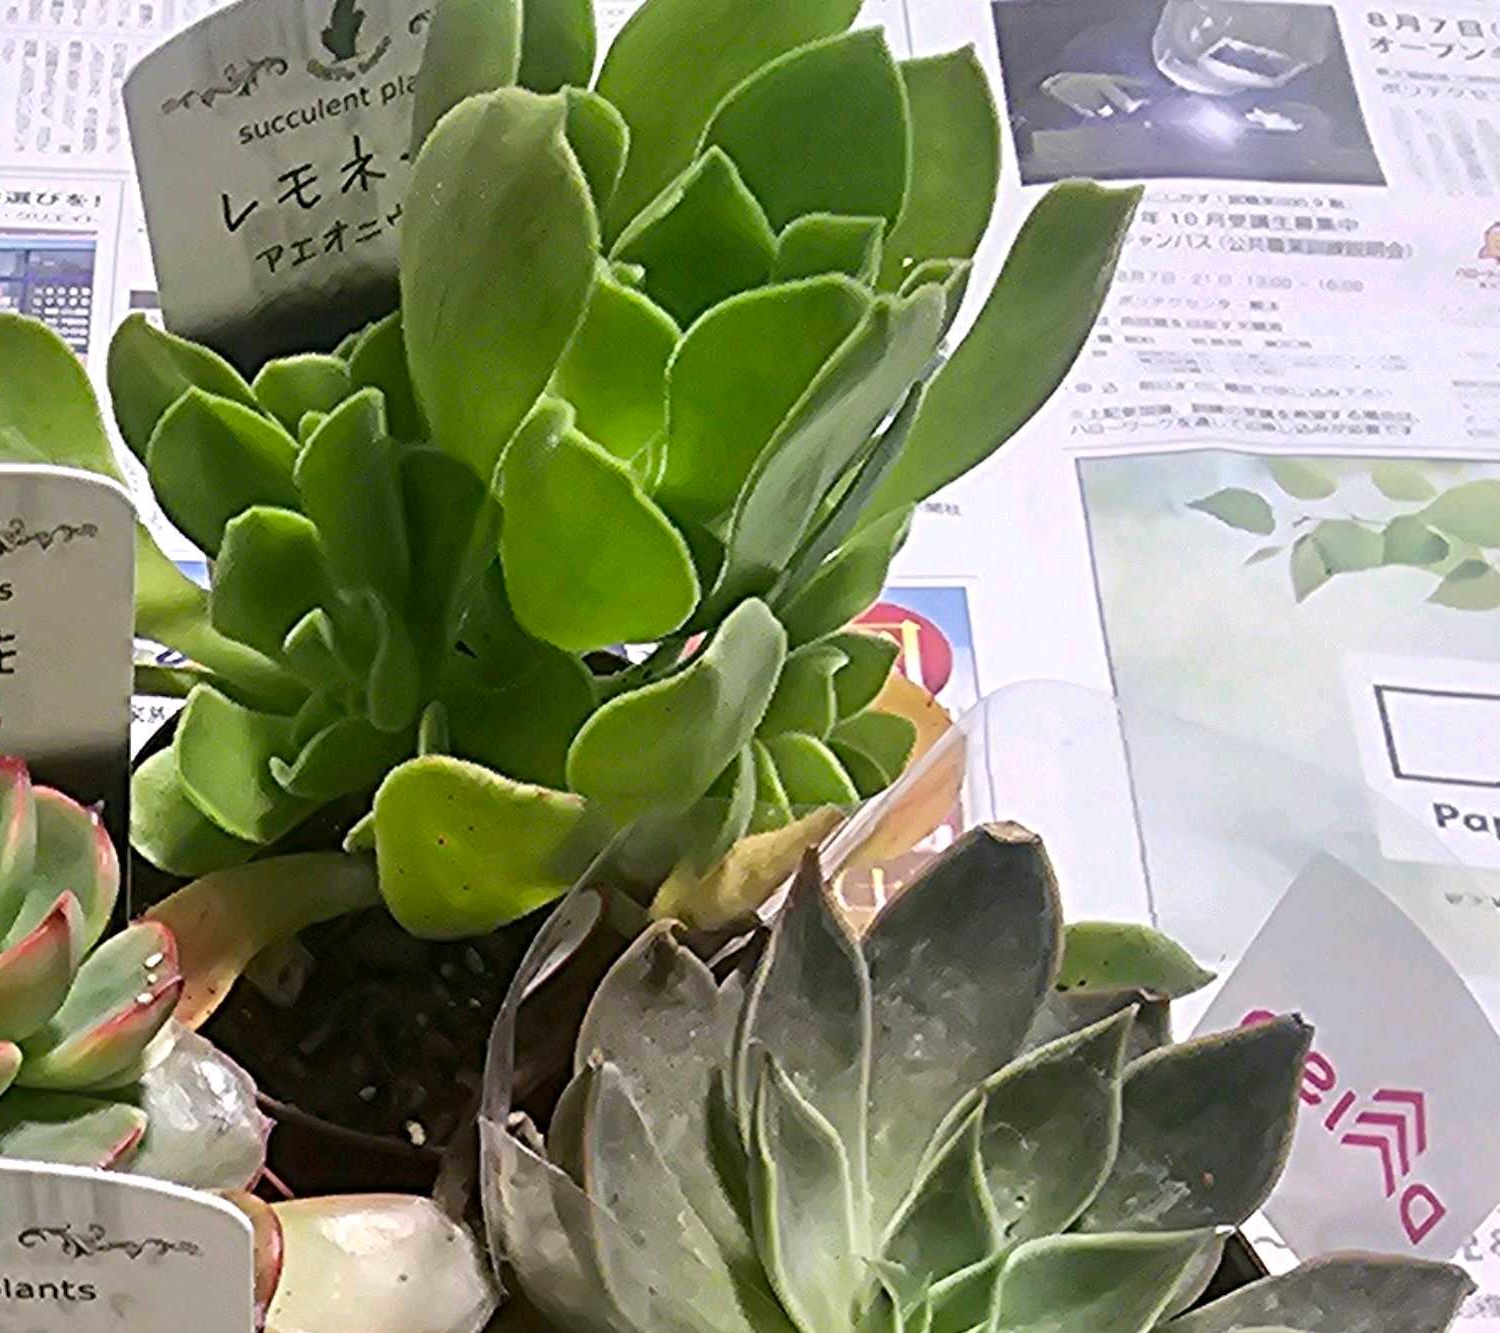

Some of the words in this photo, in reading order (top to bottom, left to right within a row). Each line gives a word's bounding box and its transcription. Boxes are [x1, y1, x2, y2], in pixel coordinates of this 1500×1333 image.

[238, 87, 370, 145] succulent
[221, 134, 410, 233] レモネ
